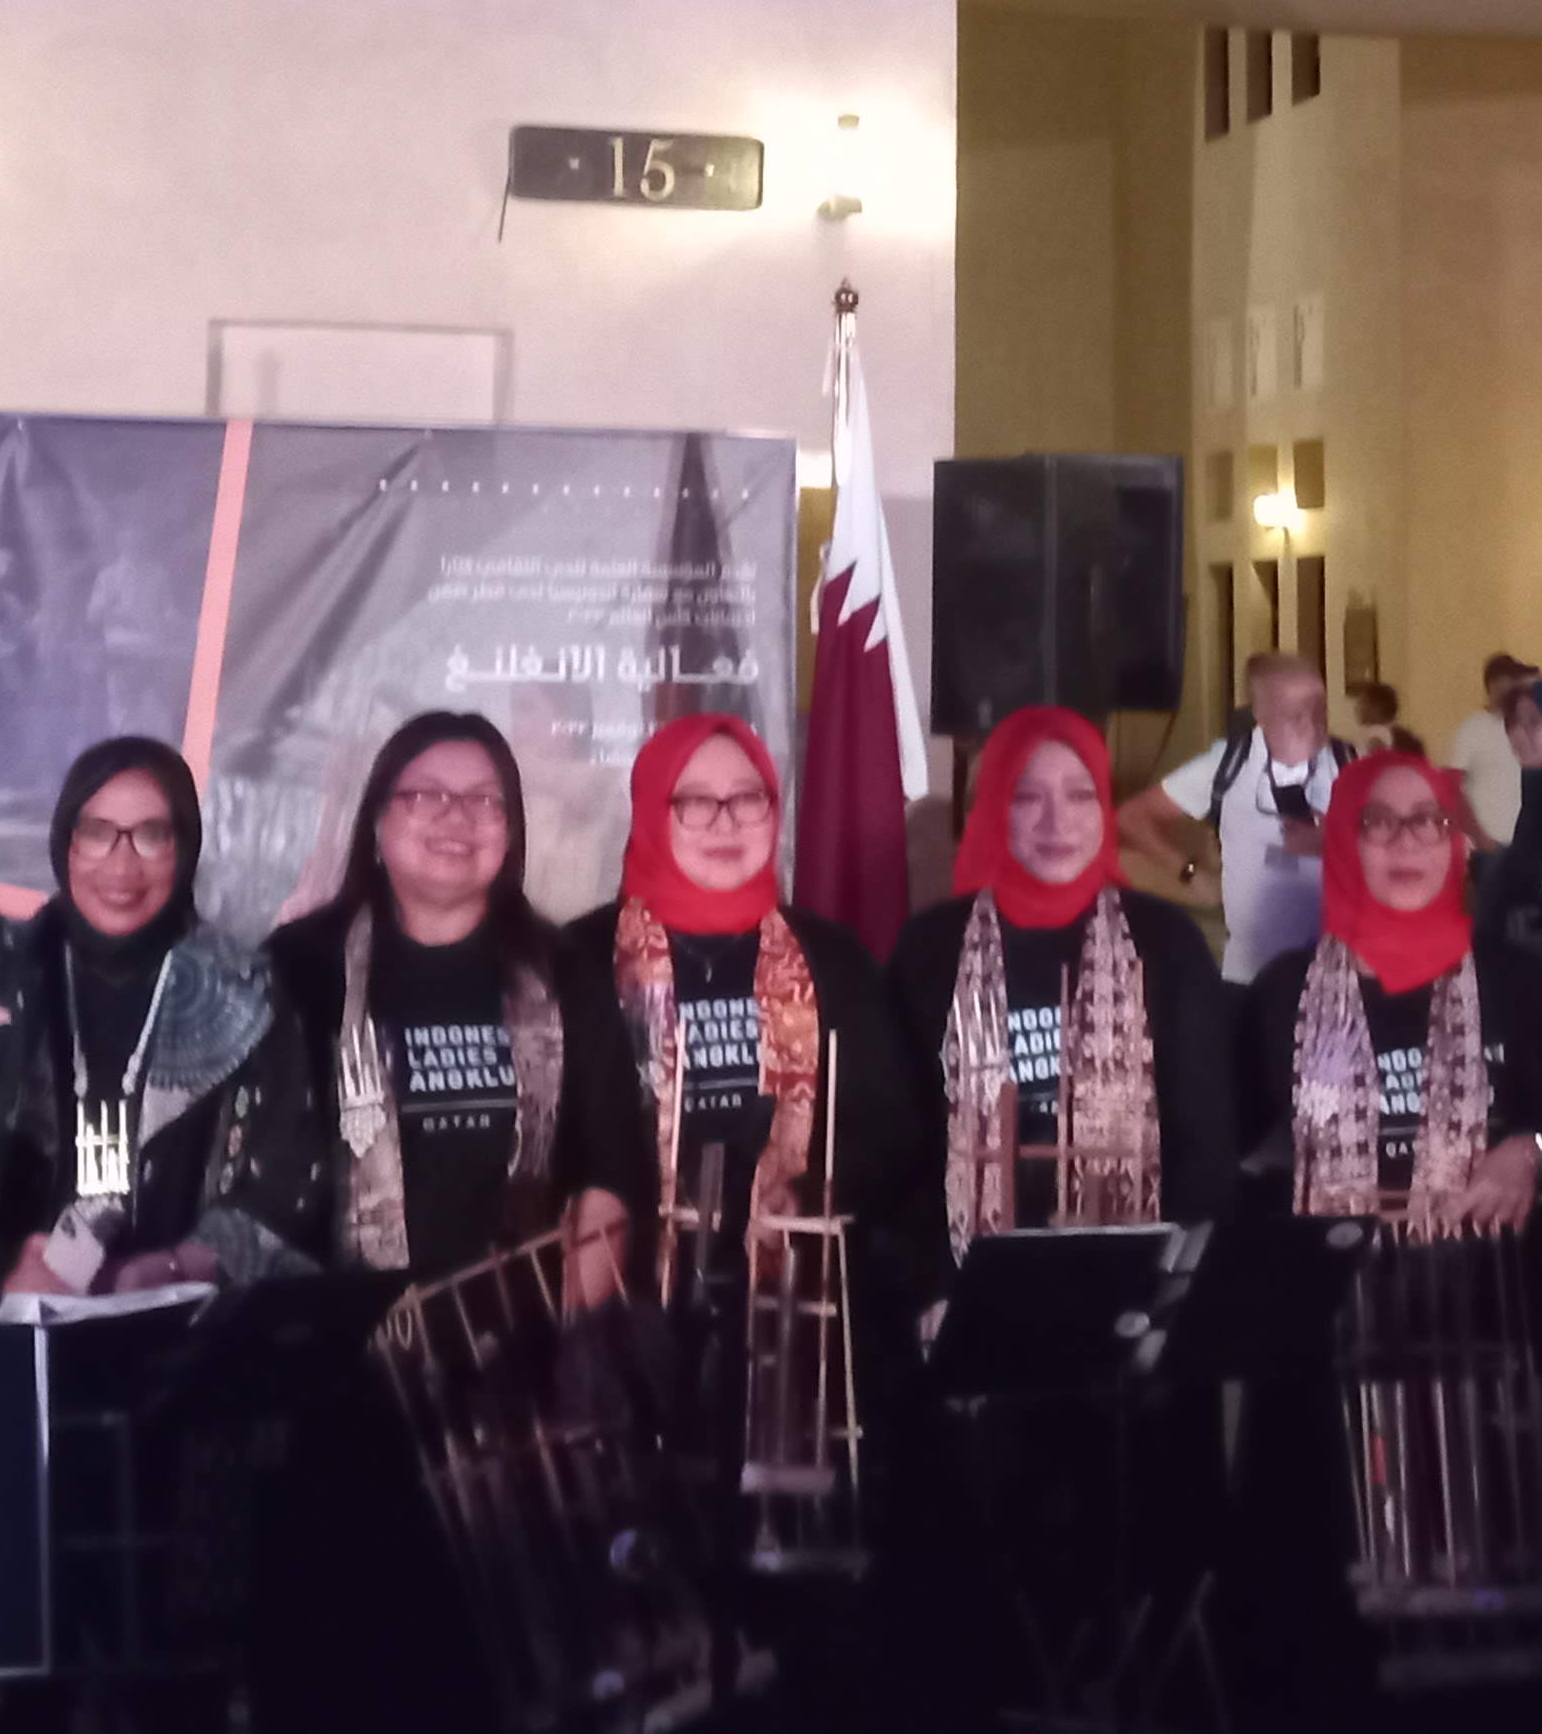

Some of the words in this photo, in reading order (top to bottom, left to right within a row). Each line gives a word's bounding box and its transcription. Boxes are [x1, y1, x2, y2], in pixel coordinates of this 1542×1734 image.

[612, 137, 676, 202] 15
[404, 1024, 511, 1047] INDONES
[688, 1018, 759, 1045] ADIES
[408, 1046, 498, 1071] LADIES
